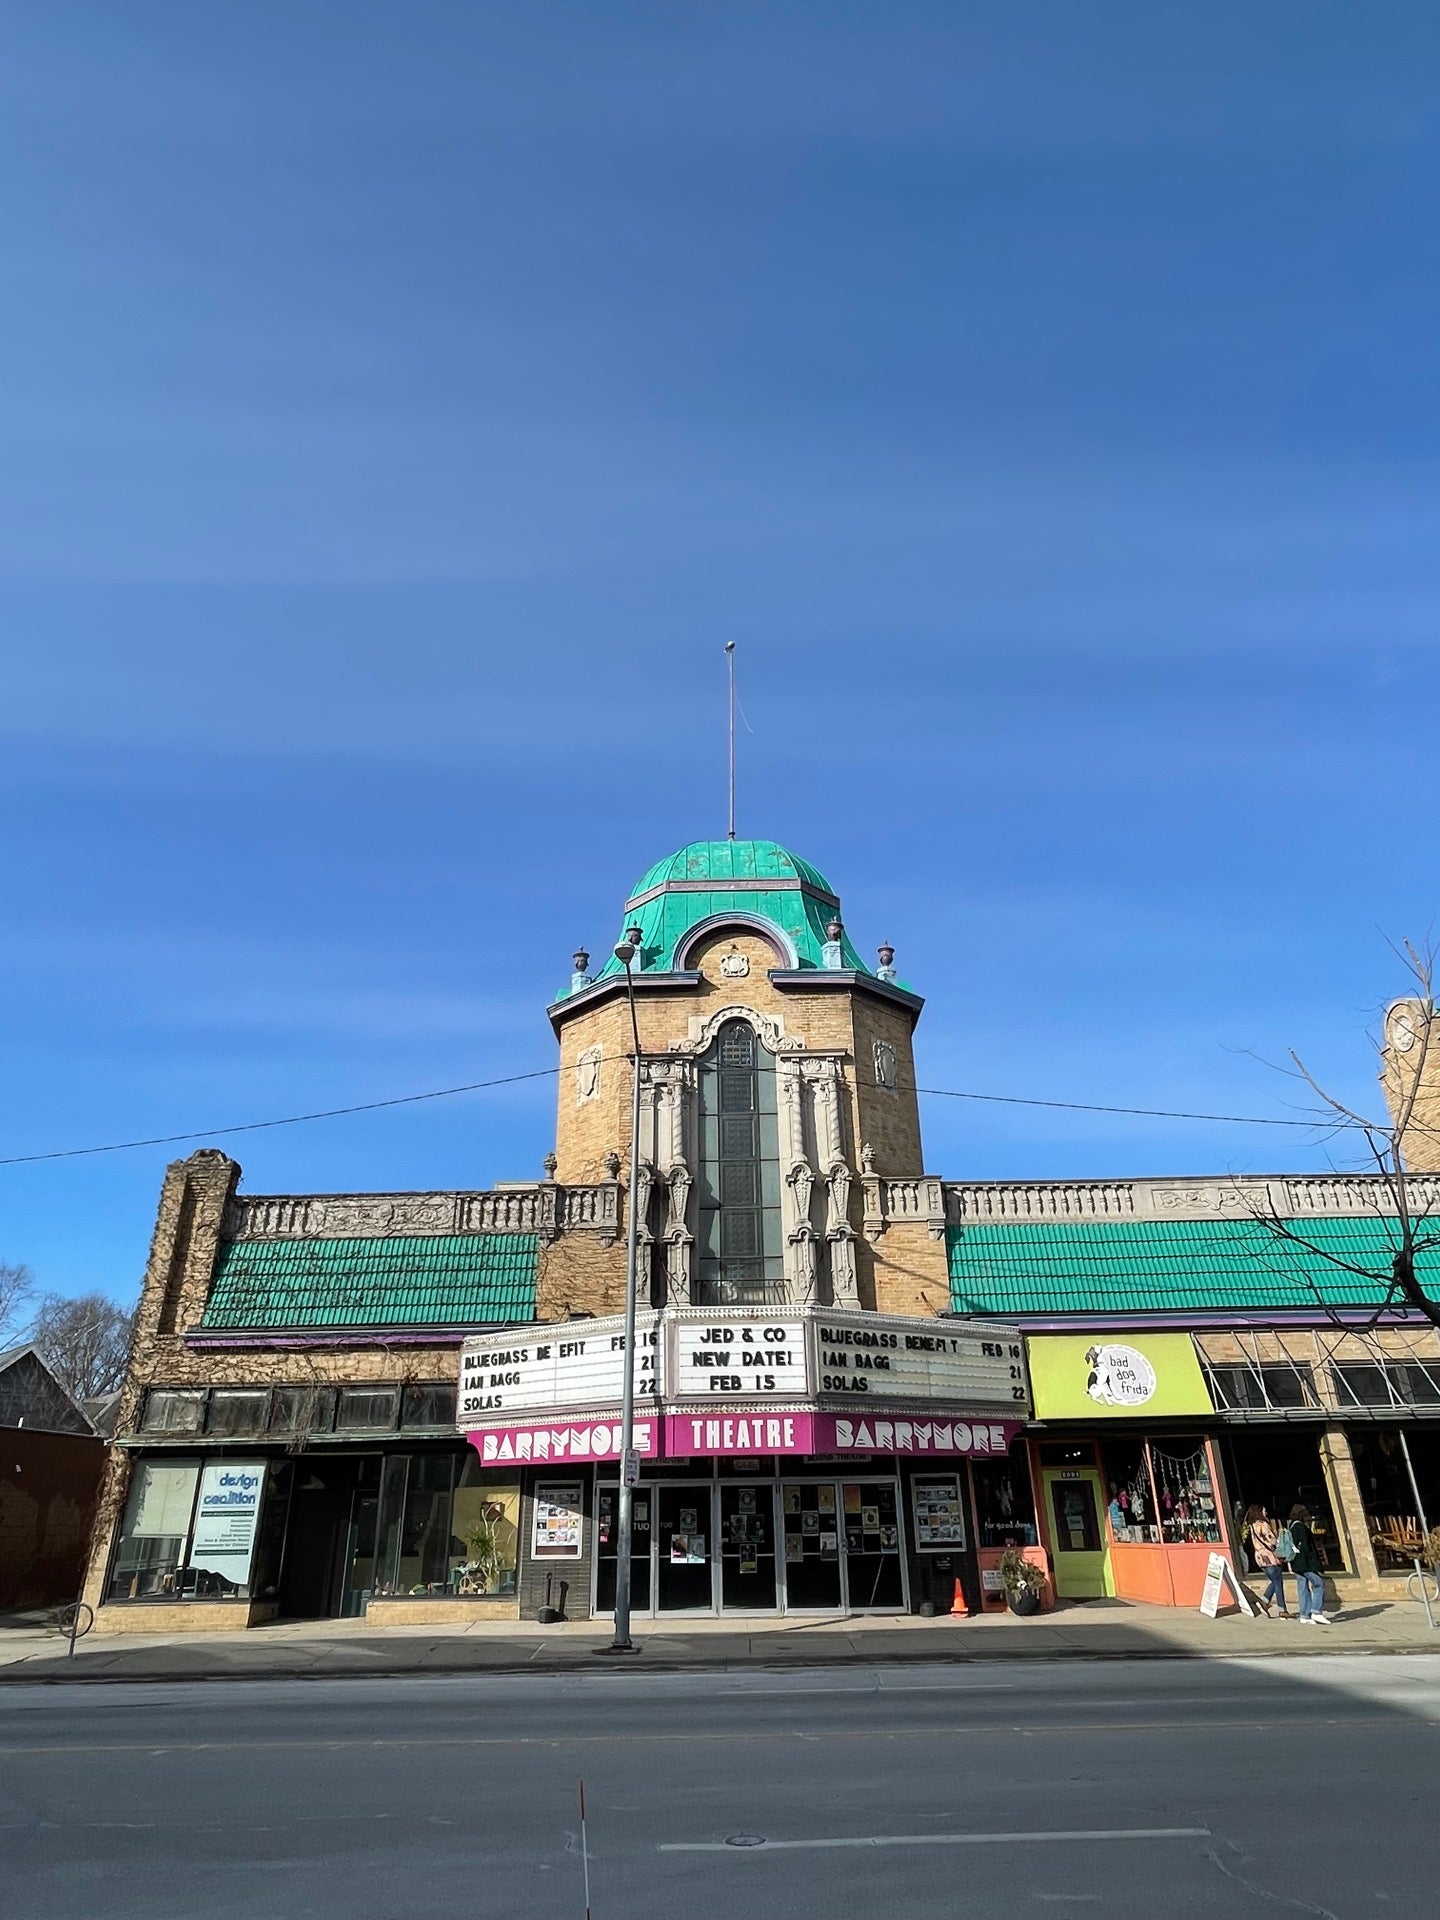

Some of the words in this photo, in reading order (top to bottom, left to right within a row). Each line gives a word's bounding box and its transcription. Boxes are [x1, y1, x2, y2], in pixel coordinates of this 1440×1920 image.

[700, 1328, 734, 1343] JED
[742, 1328, 753, 1343] &
[763, 1328, 786, 1343] CO
[820, 1328, 897, 1348] BLUEGRASS
[981, 1343, 1003, 1357] FEB
[1008, 1344, 1020, 1358] 16
[464, 1349, 528, 1370] BLUEGRASS
[559, 1341, 585, 1358] EFIT
[611, 1335, 636, 1351] FE
[643, 1332, 657, 1347] 16
[692, 1352, 730, 1367] NEW
[742, 1351, 792, 1366] DATE!
[1110, 1355, 1128, 1367] bad
[464, 1376, 483, 1390] IAN
[491, 1372, 520, 1387] BAGG
[641, 1355, 654, 1370] 21
[823, 1352, 847, 1367] IAN
[855, 1354, 890, 1370] BAGG
[1009, 1365, 1021, 1379] 21
[1116, 1368, 1136, 1381] dog
[709, 1375, 742, 1390] FEB
[756, 1375, 775, 1390] 15
[822, 1375, 868, 1391] SOLAS
[1011, 1386, 1025, 1400] 22
[1121, 1381, 1148, 1395] frida
[464, 1395, 502, 1411] SOLAS
[639, 1378, 657, 1394] 22
[691, 1418, 795, 1448] THEATRE
[835, 1419, 1006, 1453] BARRYMORE
[220, 1473, 258, 1490] design
[204, 1491, 255, 1504] coalition
